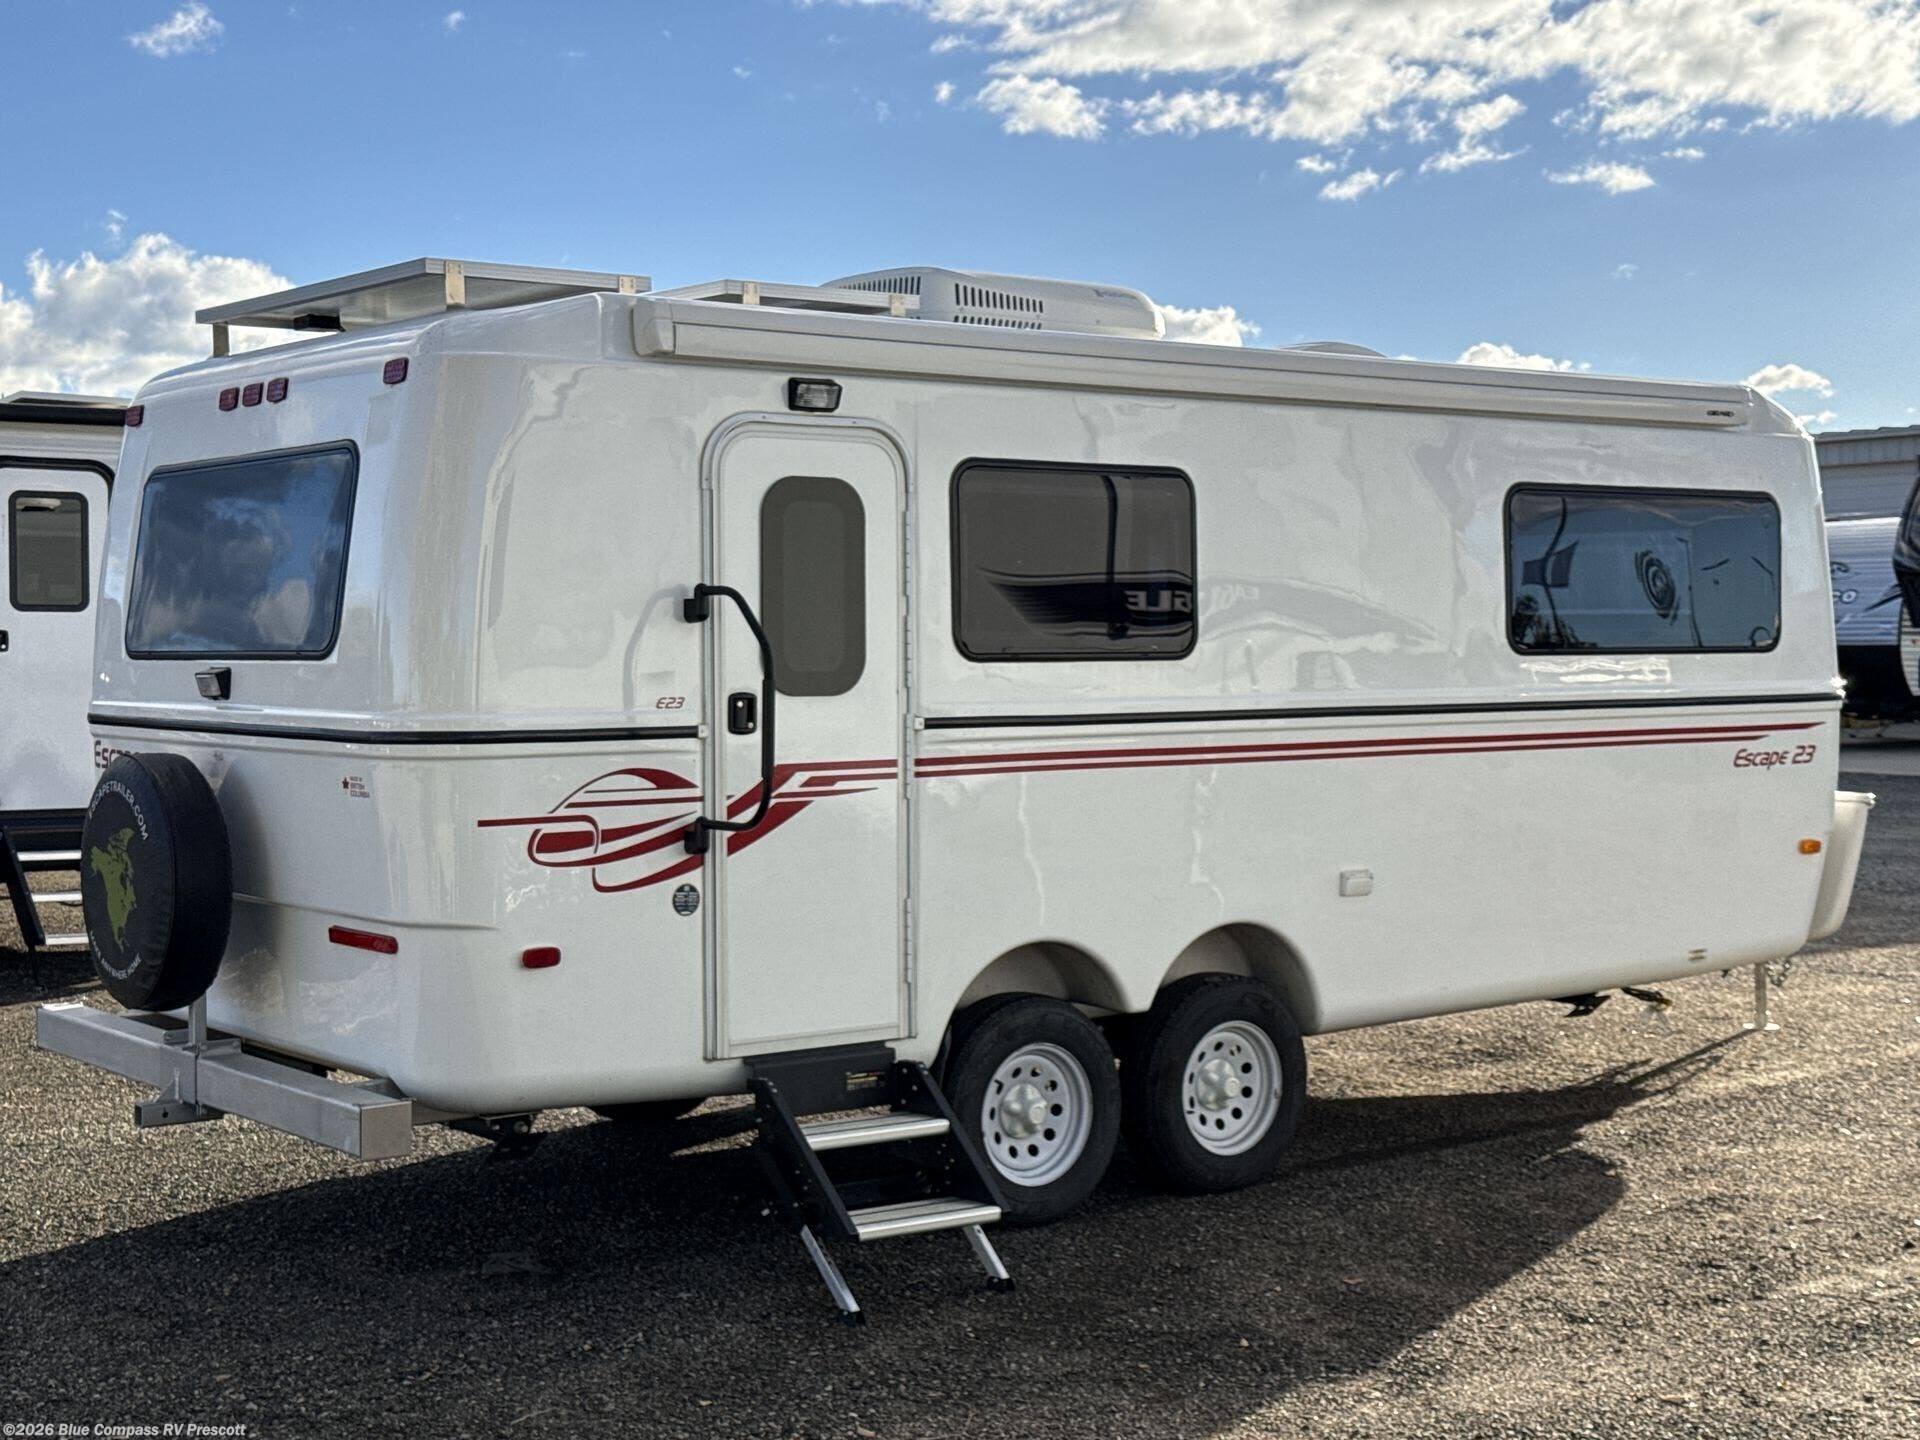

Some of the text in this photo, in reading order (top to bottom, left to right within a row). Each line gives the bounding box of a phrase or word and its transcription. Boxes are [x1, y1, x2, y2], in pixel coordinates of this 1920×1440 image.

[656, 697, 686, 709] E23
[1733, 744, 1817, 771] Escape 23
